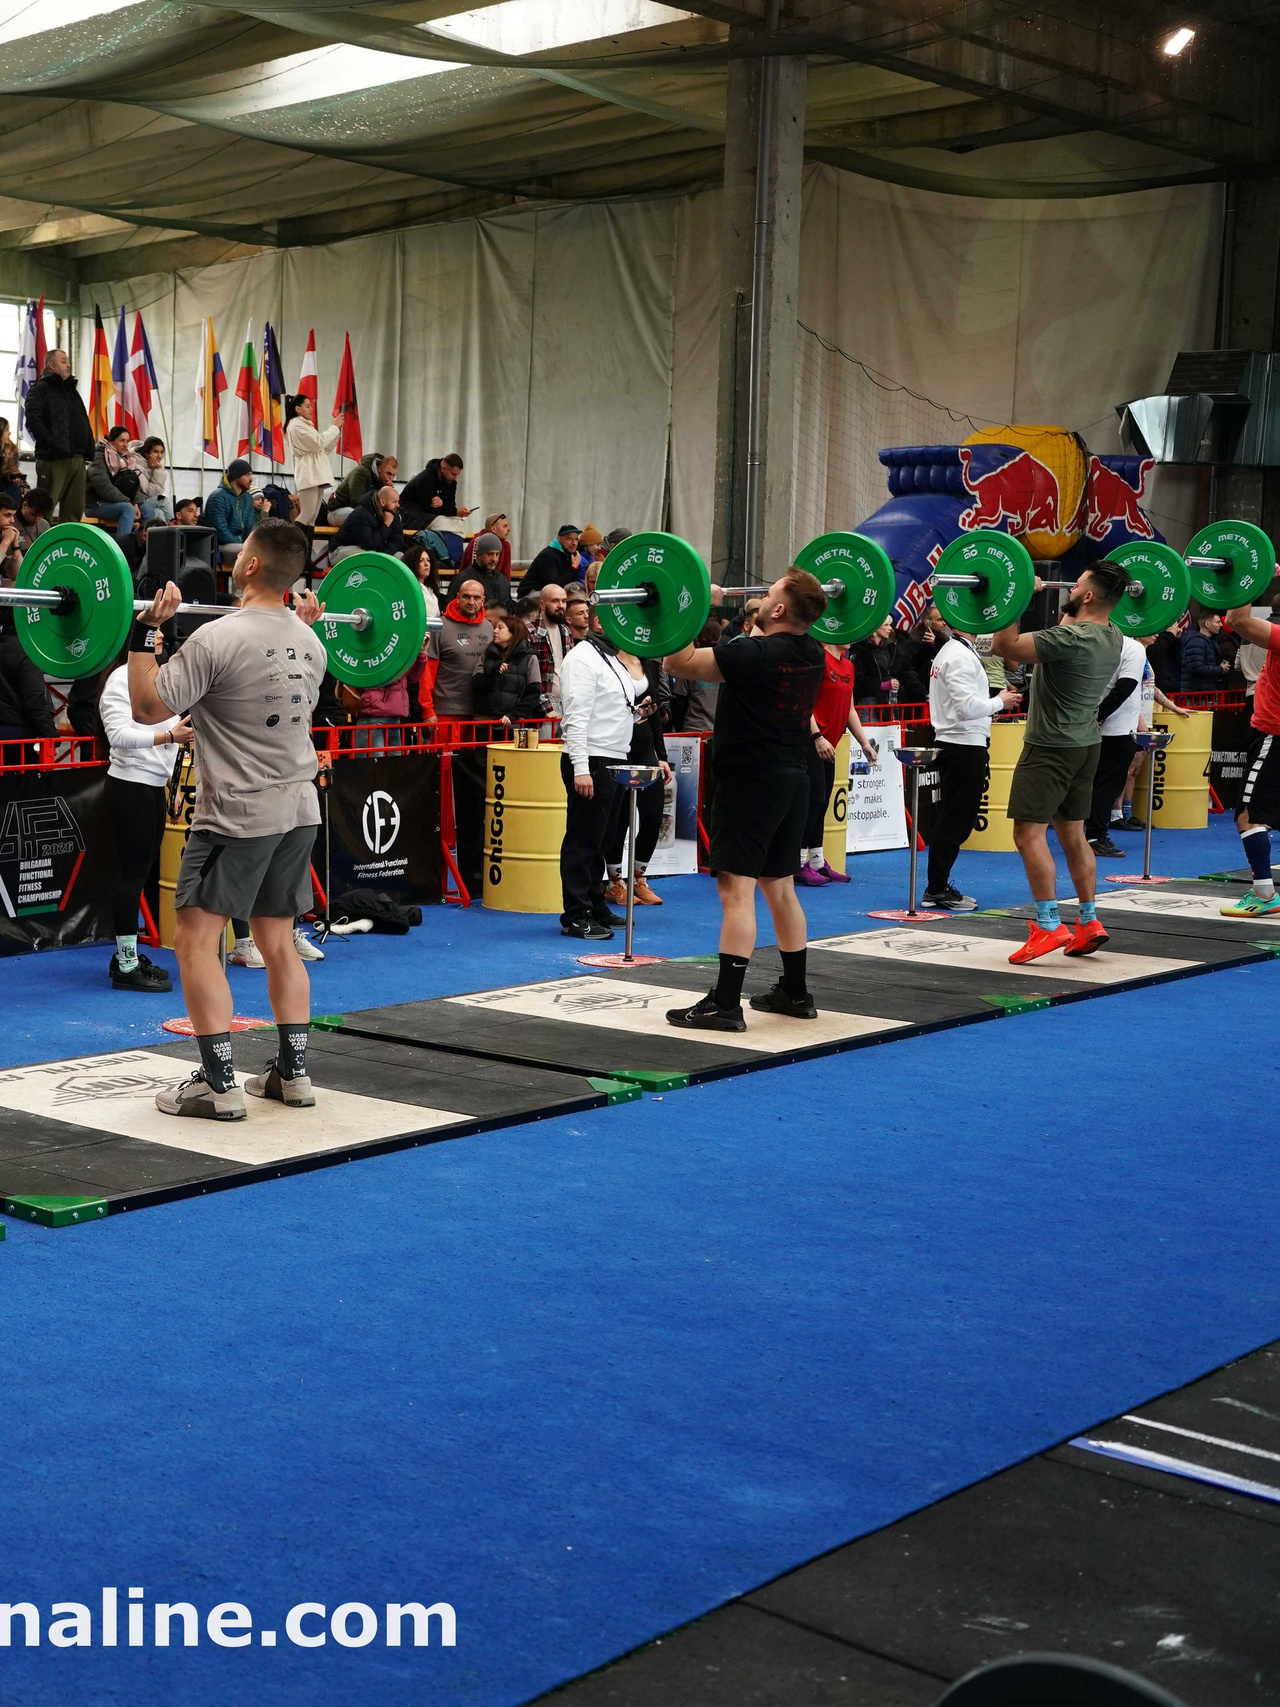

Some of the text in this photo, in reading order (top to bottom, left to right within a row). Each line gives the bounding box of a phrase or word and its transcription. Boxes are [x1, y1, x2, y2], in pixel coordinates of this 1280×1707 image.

[967, 544, 978, 557] 10
[1197, 545, 1208, 556] KG
[1201, 540, 1212, 551] 10
[1218, 533, 1259, 570] METAL ART
[647, 547, 657, 562] KG
[654, 548, 665, 564] 10
[962, 547, 970, 560] KG
[32, 547, 98, 588] METAL ART
[617, 553, 639, 576] ART
[814, 548, 874, 580] METAL ART
[1154, 561, 1172, 579] ART
[987, 546, 1016, 606] METAL ART
[1243, 574, 1255, 586] KG
[95, 577, 109, 590] KG
[1163, 586, 1175, 594] KG
[1239, 579, 1251, 590] 10
[96, 589, 111, 602] 10
[865, 587, 877, 598] KG
[1161, 592, 1175, 601] 10
[392, 600, 405, 612] KG
[862, 595, 876, 606] 10
[392, 609, 407, 622] 10
[982, 607, 994, 621] 10
[989, 604, 999, 619] KG
[27, 614, 40, 624] KG
[323, 621, 337, 632] 10
[325, 629, 338, 640] KG
[634, 626, 643, 642] 10
[641, 628, 651, 643] KG
[335, 633, 400, 668] METAL ART
[871, 765, 883, 775] you
[857, 778, 886, 790] stronger.
[833, 787, 847, 823] 6
[863, 794, 883, 805] makes
[489, 765, 506, 886] Oh!Good
[41, 841, 74, 857] 2026
[19, 859, 52, 870] BULGARIAN
[353, 857, 409, 871] International Functional
[19, 869, 54, 882] FUNCTIONAL
[357, 868, 405, 879] Fitness Federation
[18, 882, 42, 892] FITNESS
[17, 890, 62, 904] CHAMPIONSHIP
[23, 1054, 150, 1076] METAL
